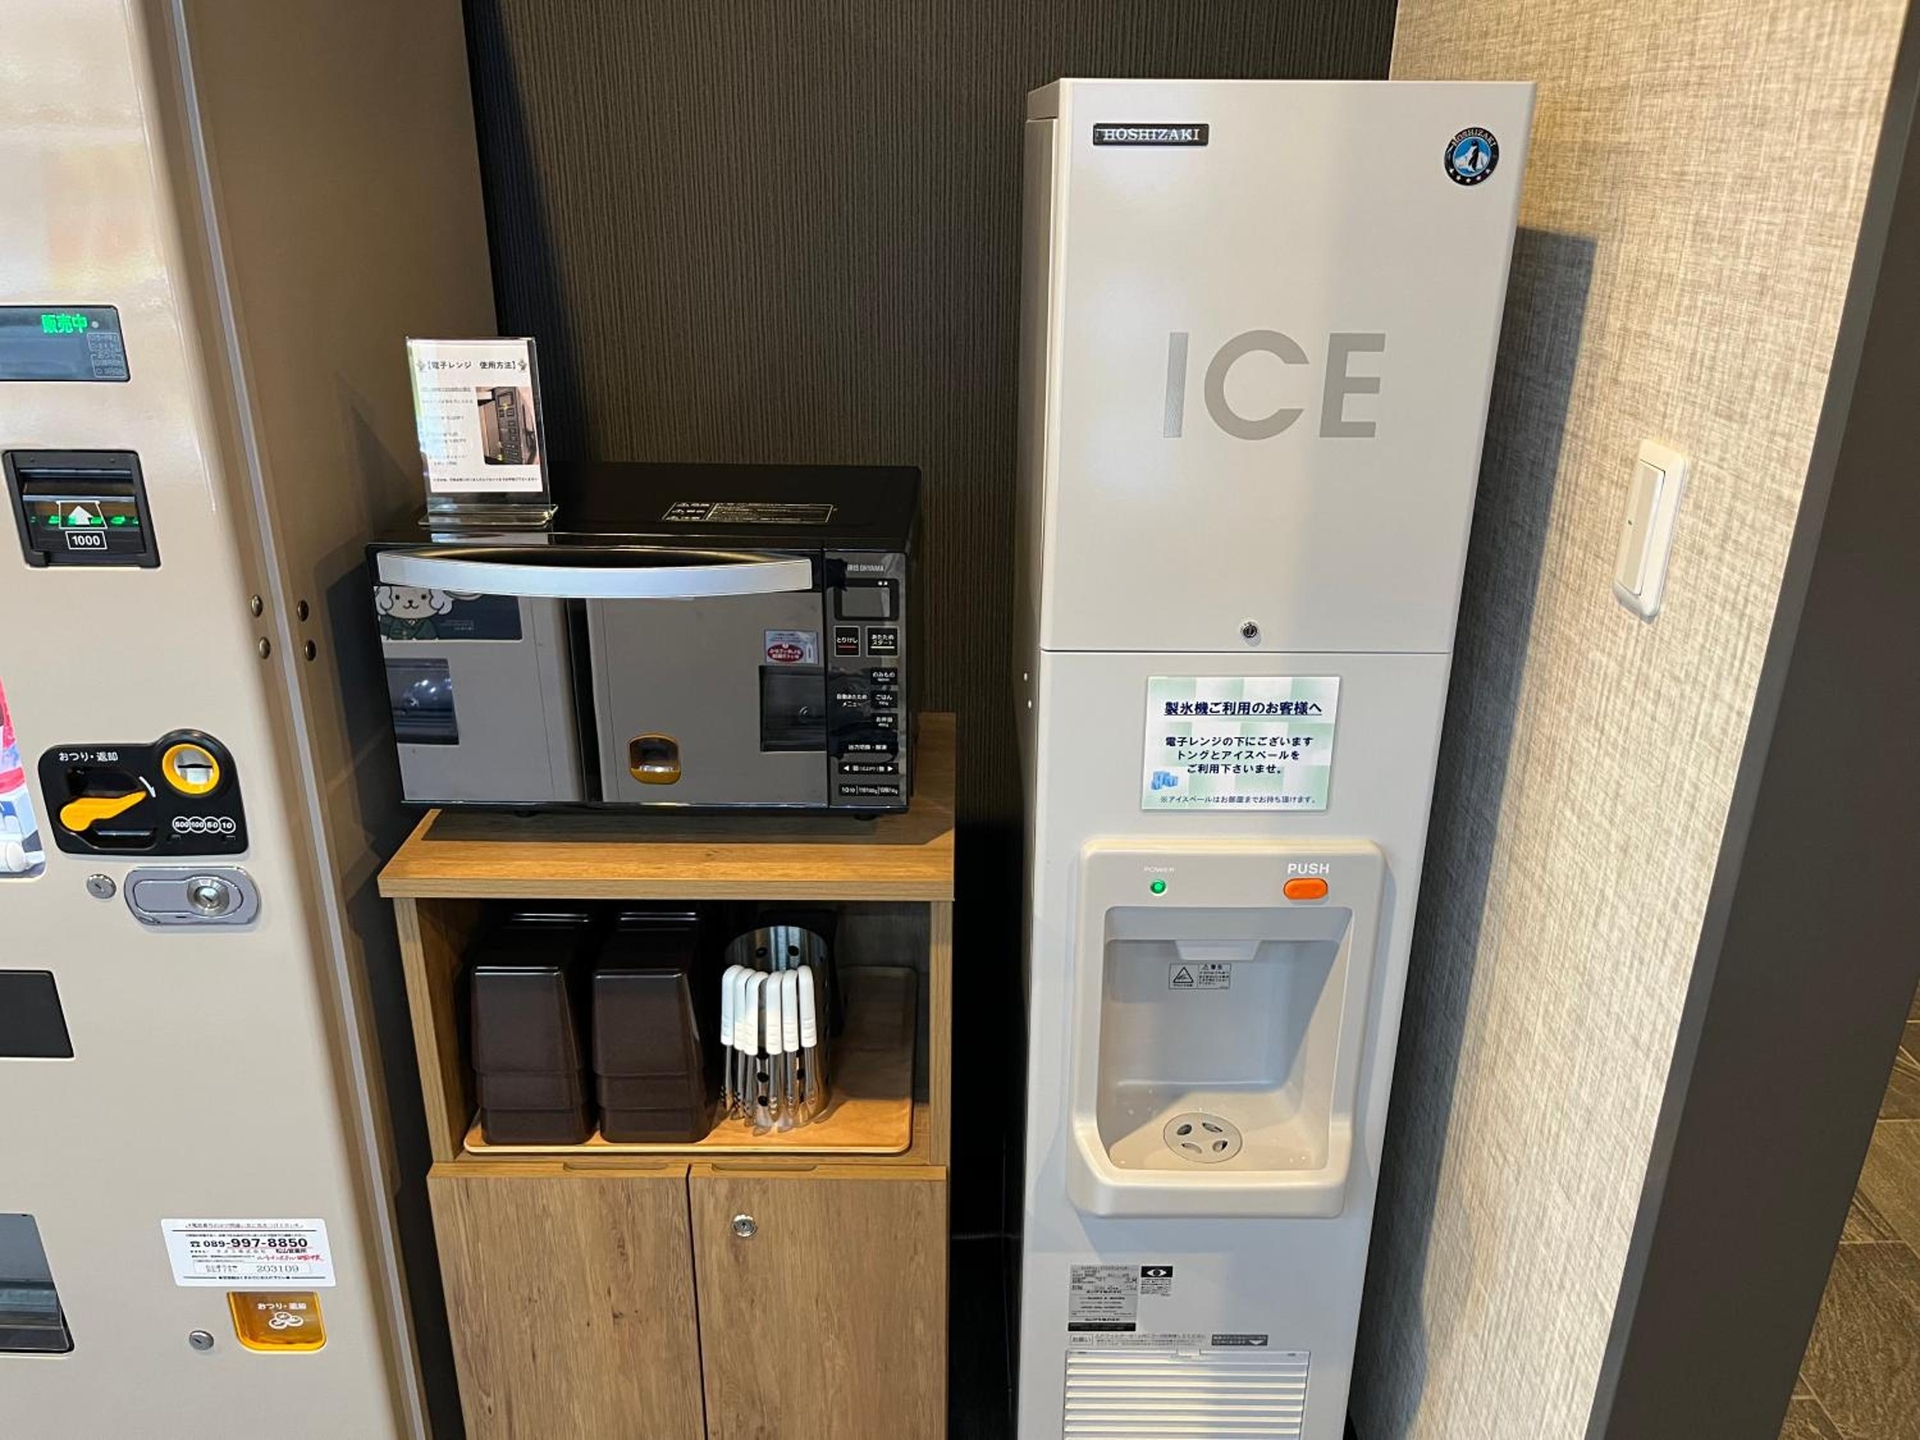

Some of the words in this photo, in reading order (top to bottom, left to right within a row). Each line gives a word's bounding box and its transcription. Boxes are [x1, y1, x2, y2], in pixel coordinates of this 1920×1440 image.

[1103, 128, 1200, 142] HOSHIZAKI
[1163, 330, 1386, 441] ICE
[71, 535, 101, 546] 1000
[1164, 701, 1322, 715] 製氷機ご利用のお客様へ
[1165, 737, 1314, 747] 電子レンジの下にございます
[59, 752, 119, 762] おつり・返却
[1177, 750, 1300, 760] トングとアイスペールを
[1187, 764, 1282, 774] ご利用下さいませ。
[207, 821, 219, 829] 50
[1287, 863, 1330, 875] PUSH
[203, 1238, 308, 1248] 089-997-8850
[256, 1264, 300, 1273] 203109
